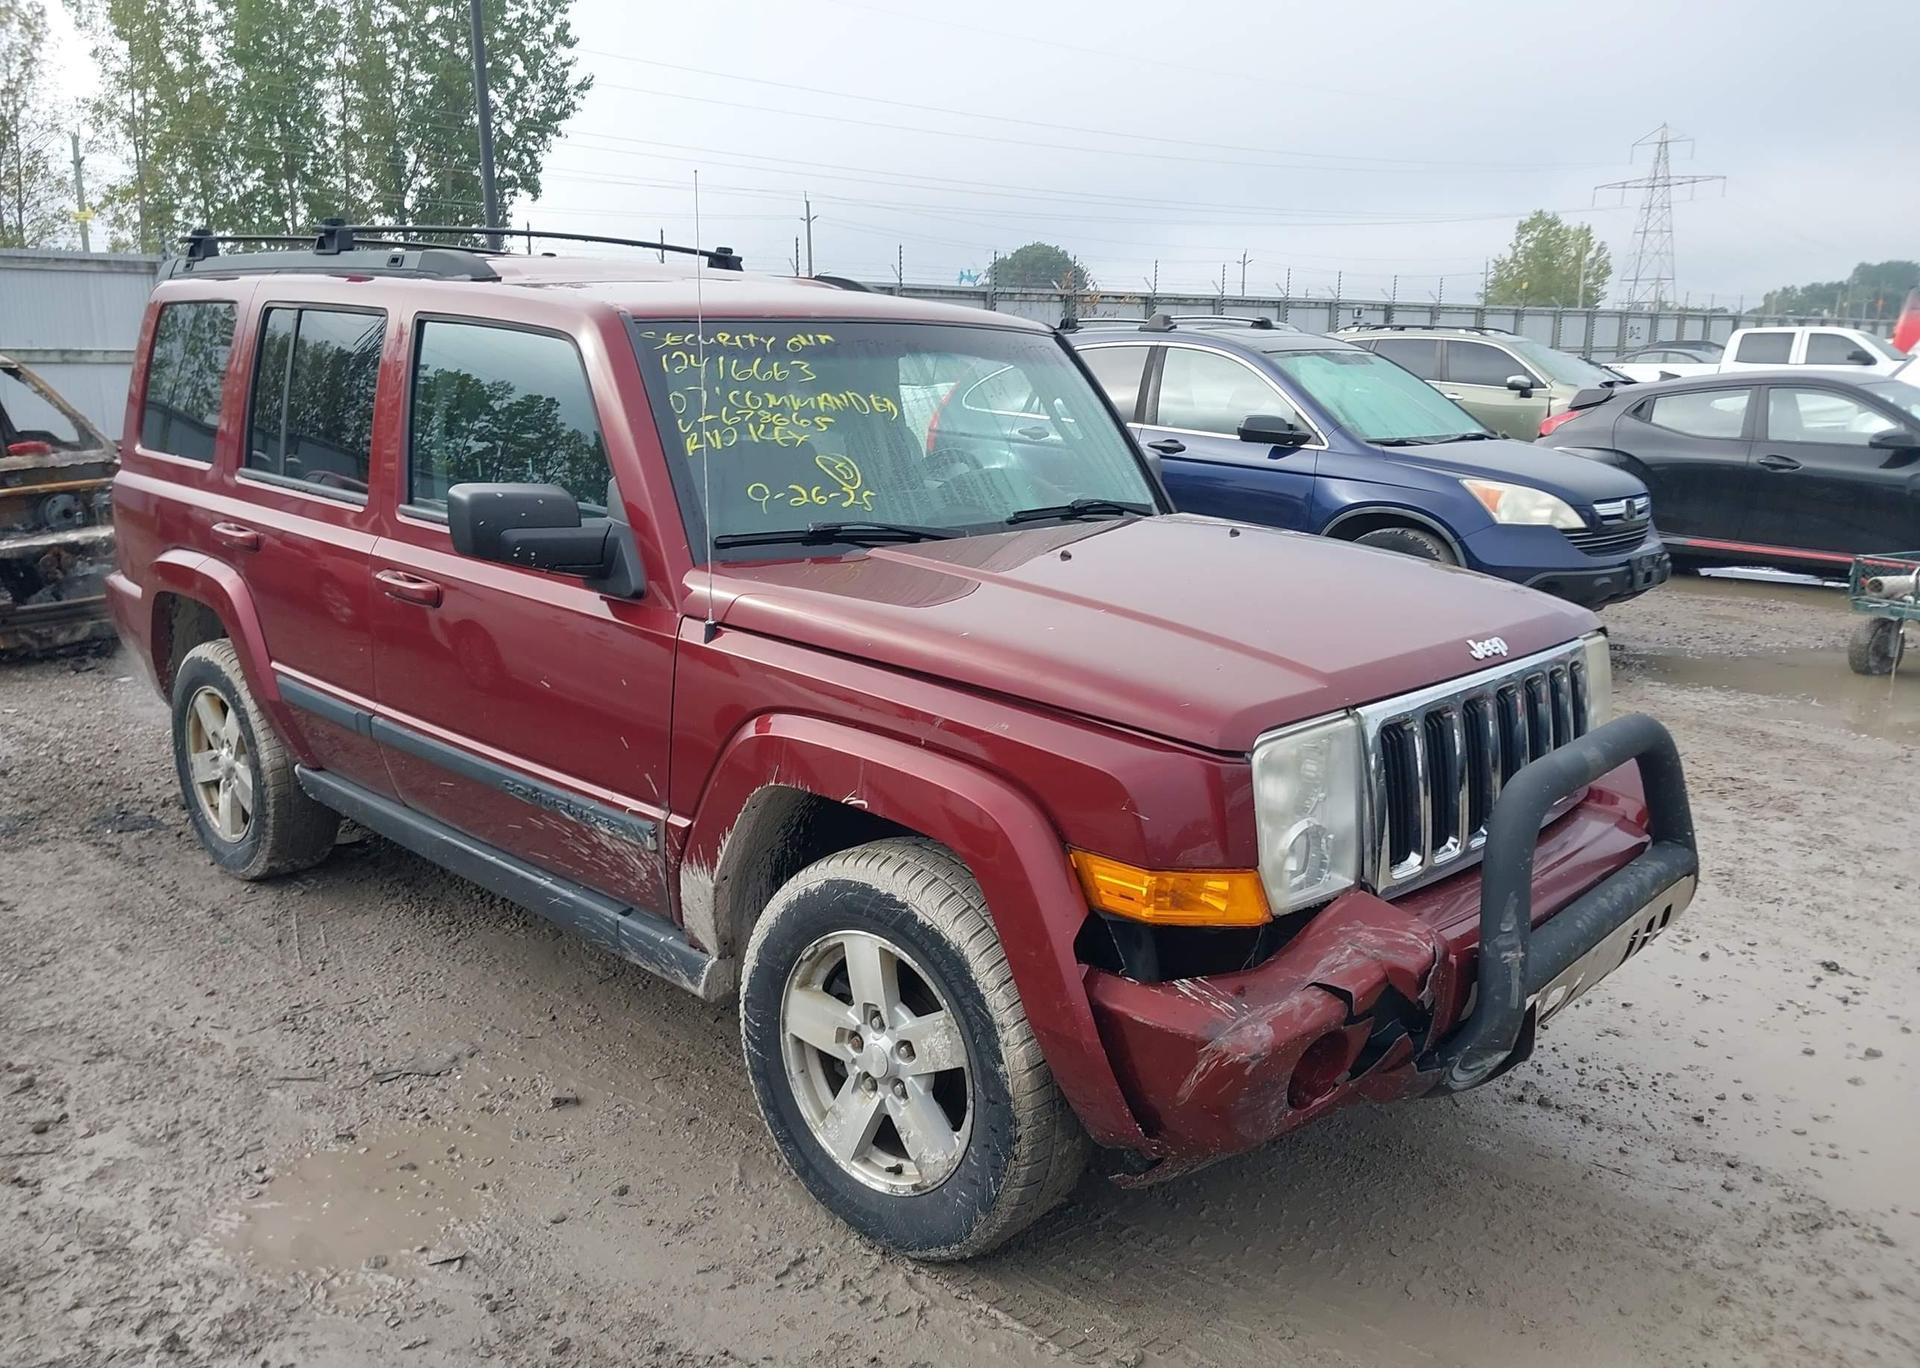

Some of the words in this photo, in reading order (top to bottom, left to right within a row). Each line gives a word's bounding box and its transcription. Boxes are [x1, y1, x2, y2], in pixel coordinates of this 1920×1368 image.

[640, 331, 777, 351] SECURITY
[749, 423, 810, 447] KEY
[747, 483, 877, 514] 9-26-25
[1465, 636, 1509, 660] Jeep
